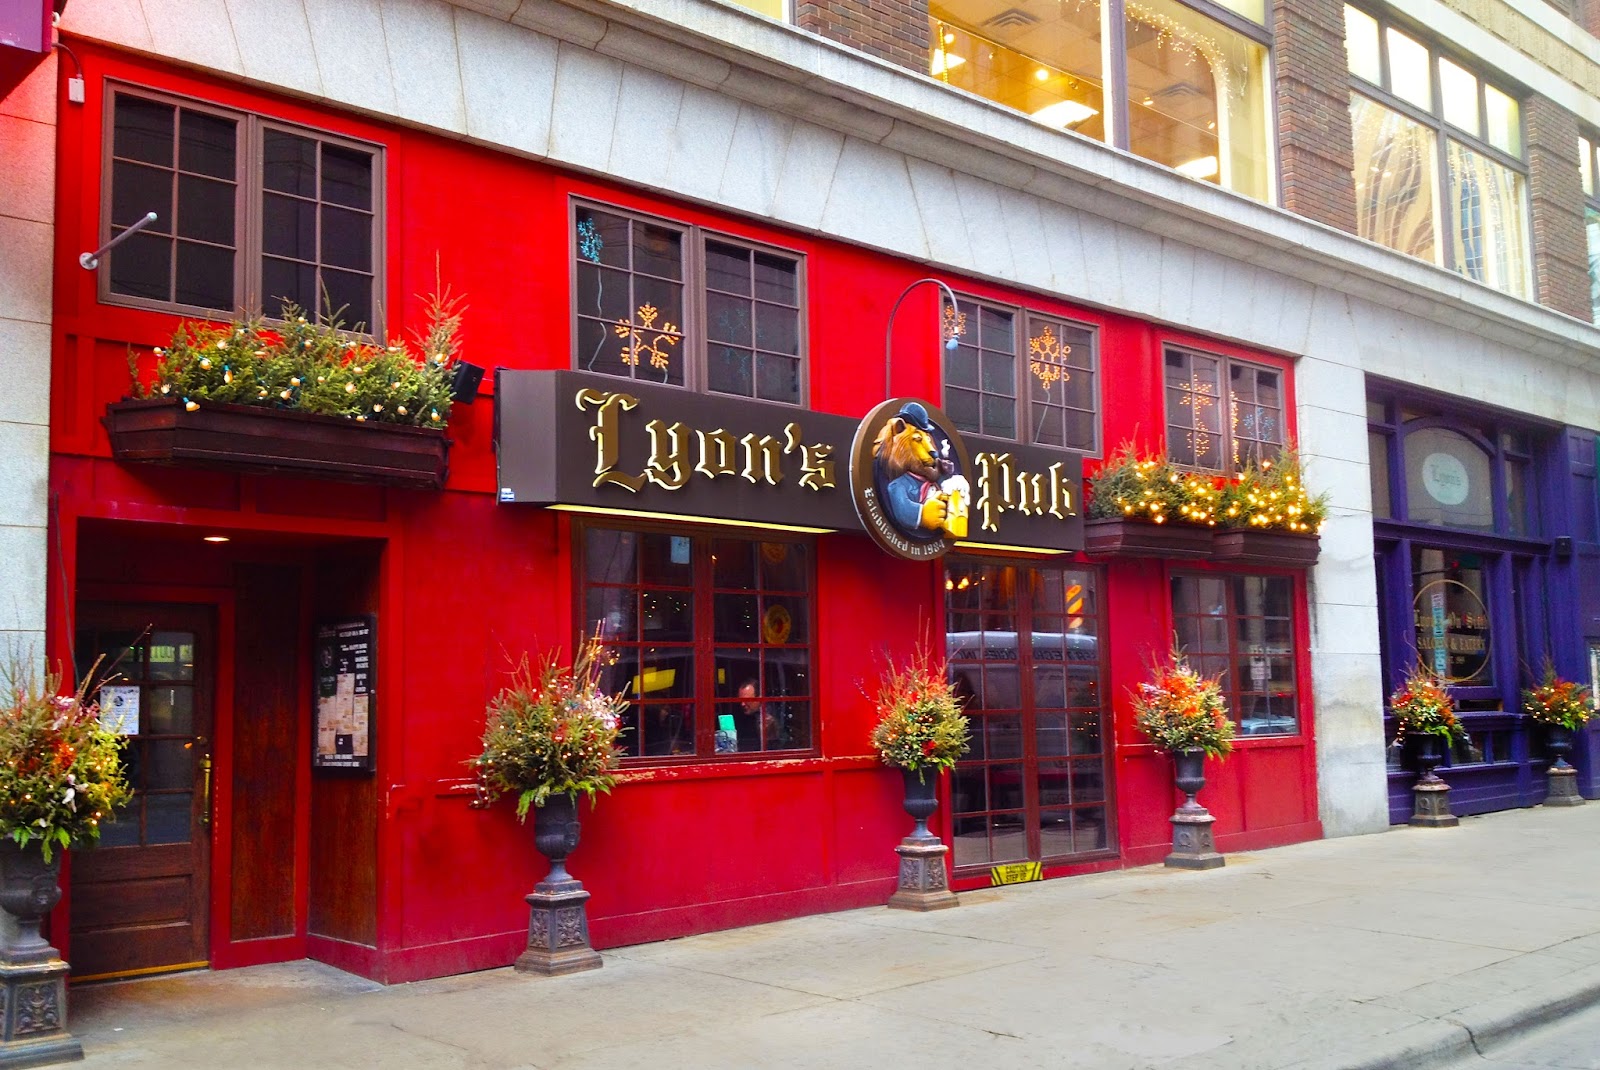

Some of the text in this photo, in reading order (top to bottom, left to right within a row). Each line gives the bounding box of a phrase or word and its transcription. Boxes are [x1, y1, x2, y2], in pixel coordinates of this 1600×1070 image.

[575, 388, 1078, 532] Lyon's Pub
[864, 487, 945, 555] Established in 1984
